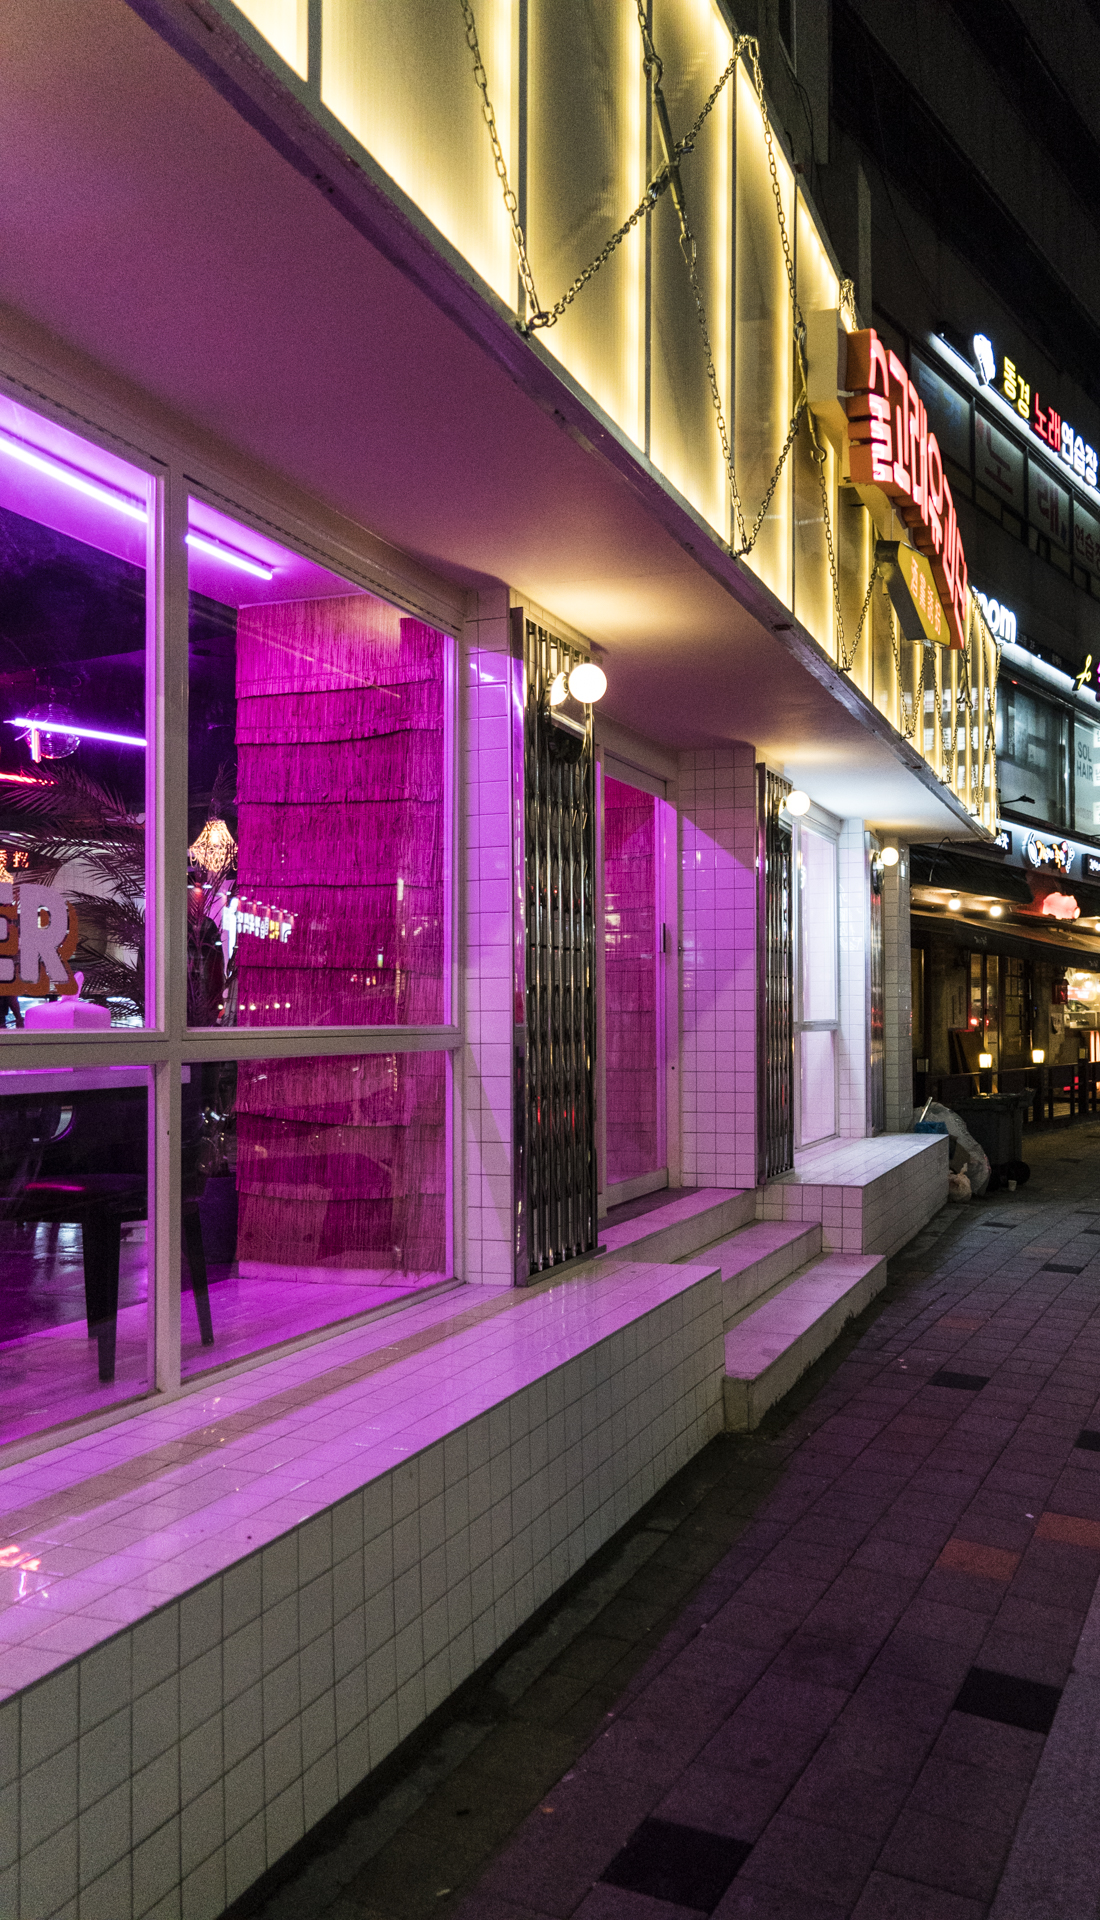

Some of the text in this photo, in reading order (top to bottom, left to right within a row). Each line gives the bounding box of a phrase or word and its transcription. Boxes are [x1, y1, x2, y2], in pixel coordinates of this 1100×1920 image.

[1003, 356, 1030, 419] 동경
[1077, 741, 1092, 762] SOL
[1076, 760, 1094, 782] HAIR
